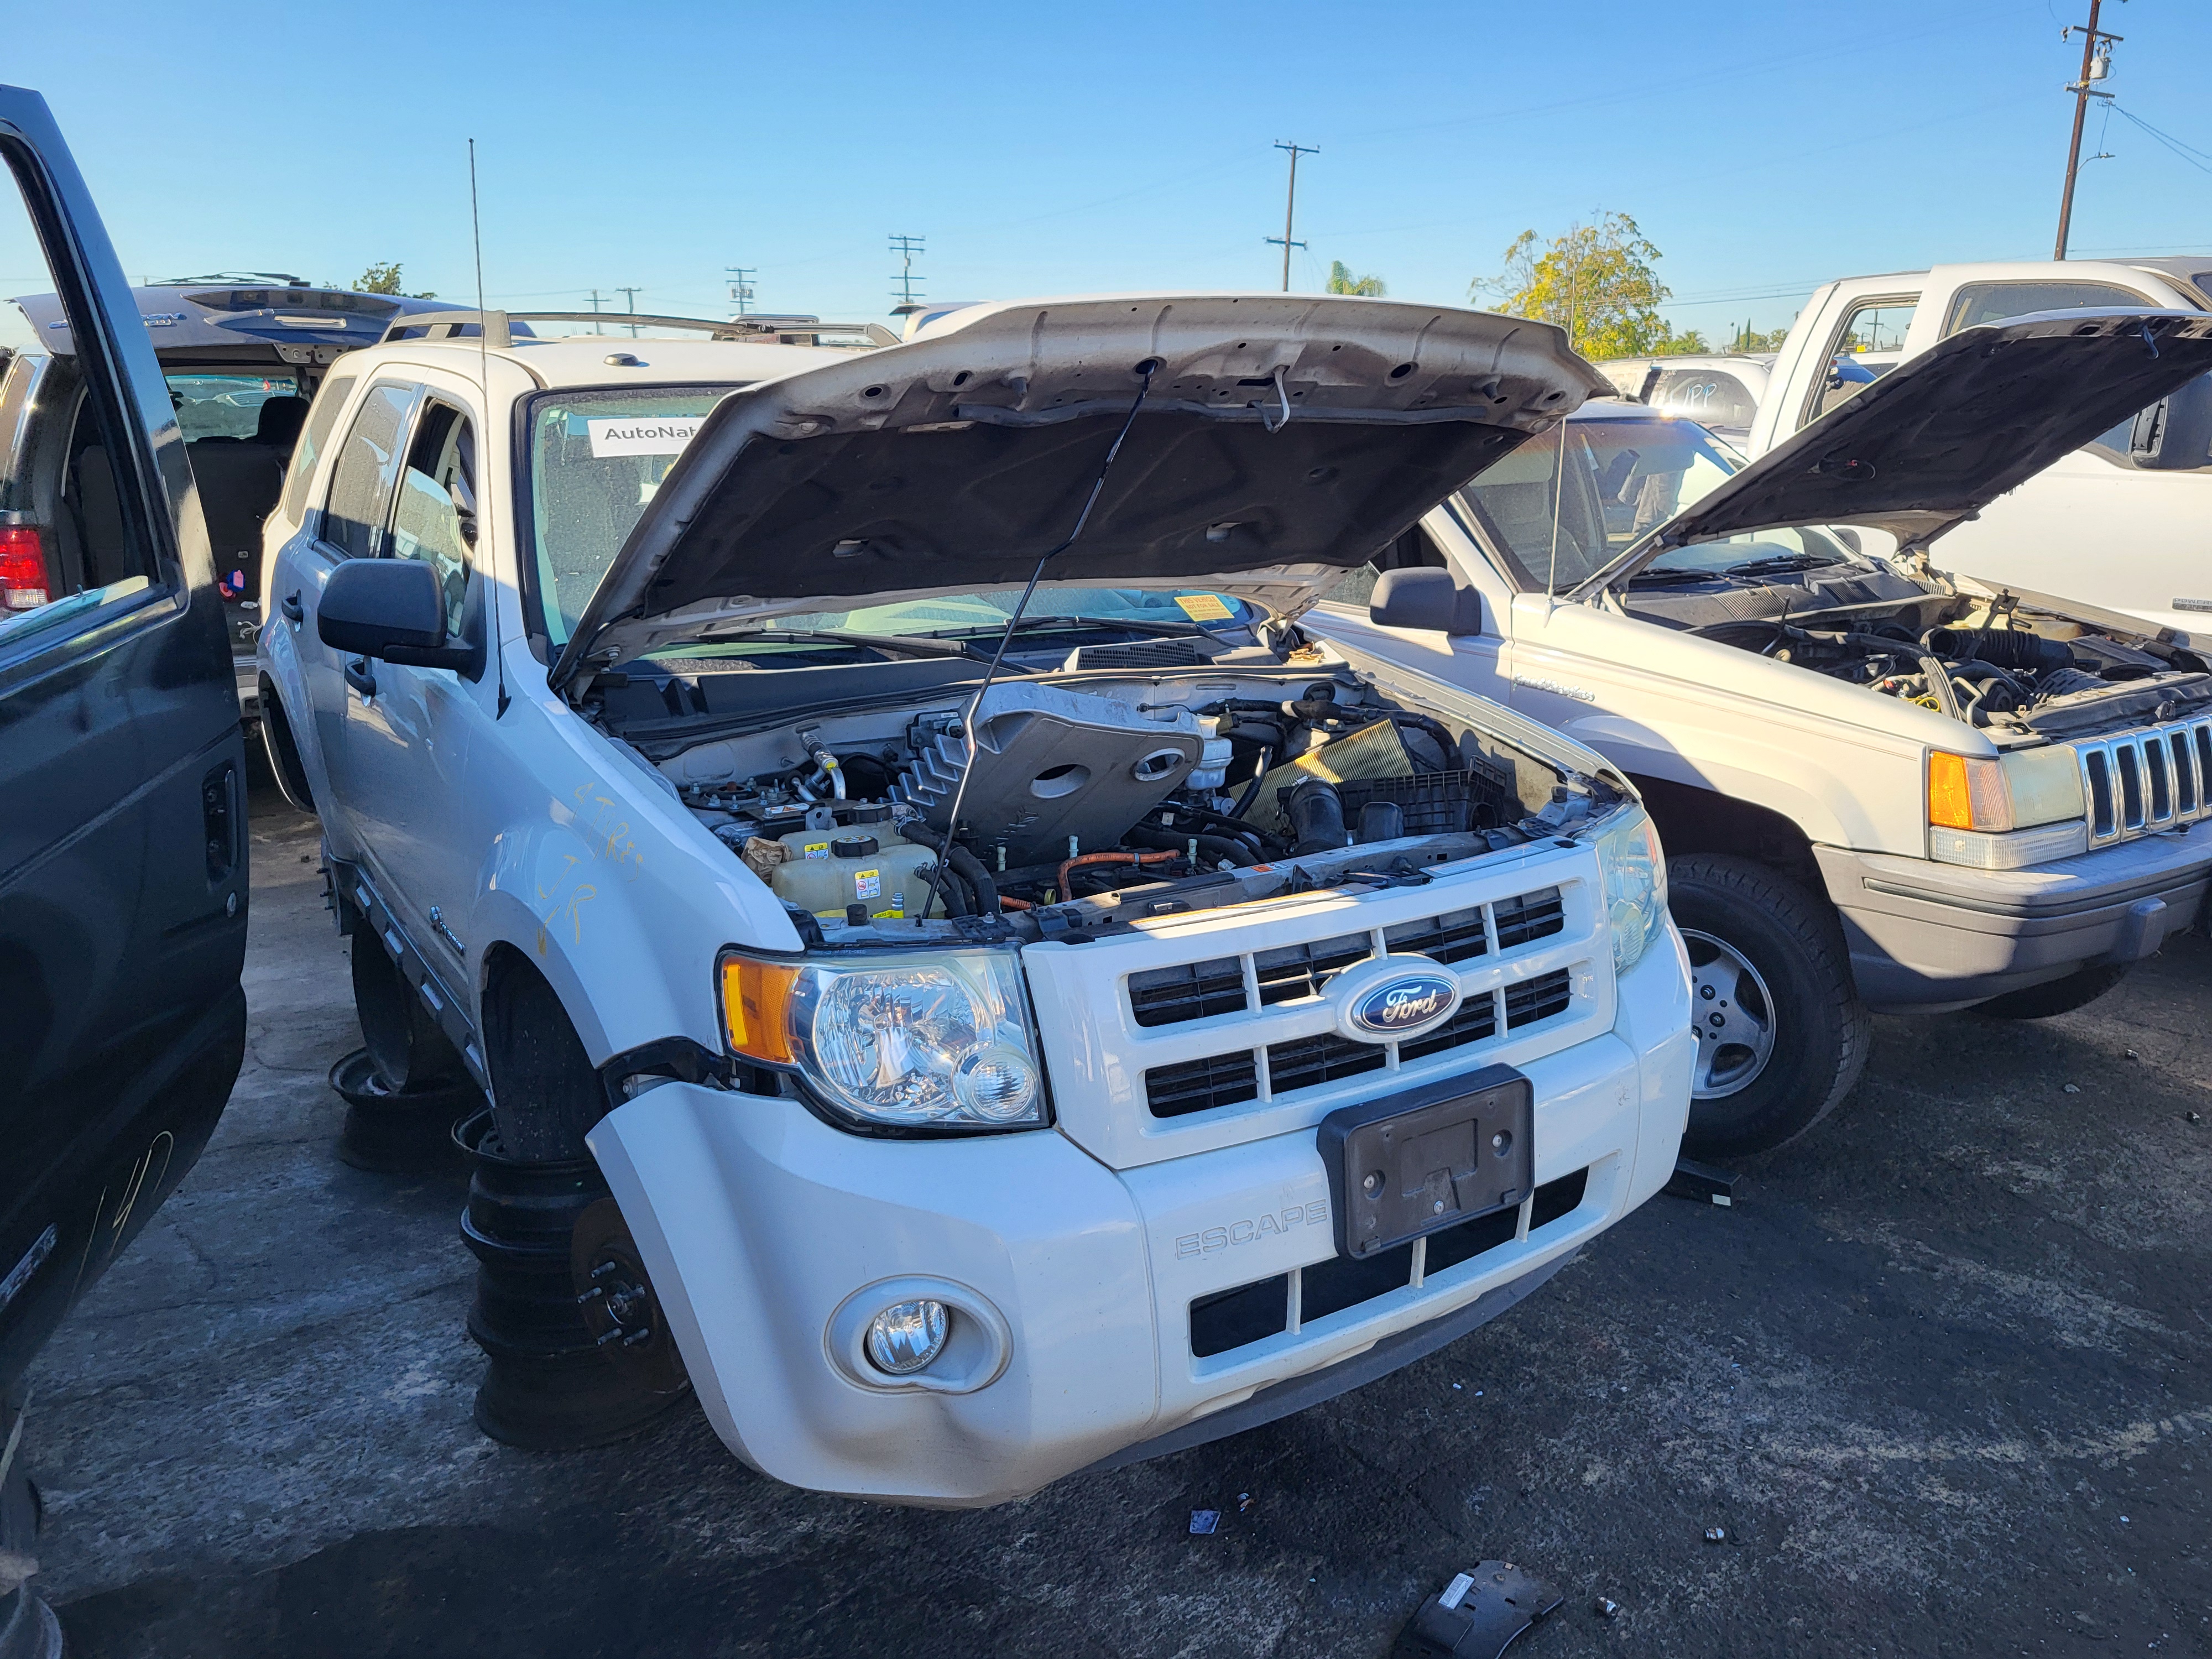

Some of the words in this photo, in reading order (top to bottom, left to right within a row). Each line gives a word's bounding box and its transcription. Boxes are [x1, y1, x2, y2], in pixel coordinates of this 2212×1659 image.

[604, 426, 697, 440] AutoNat
[1383, 985, 1437, 1023] Ford
[1175, 1198, 1328, 1260] ESCAPE
